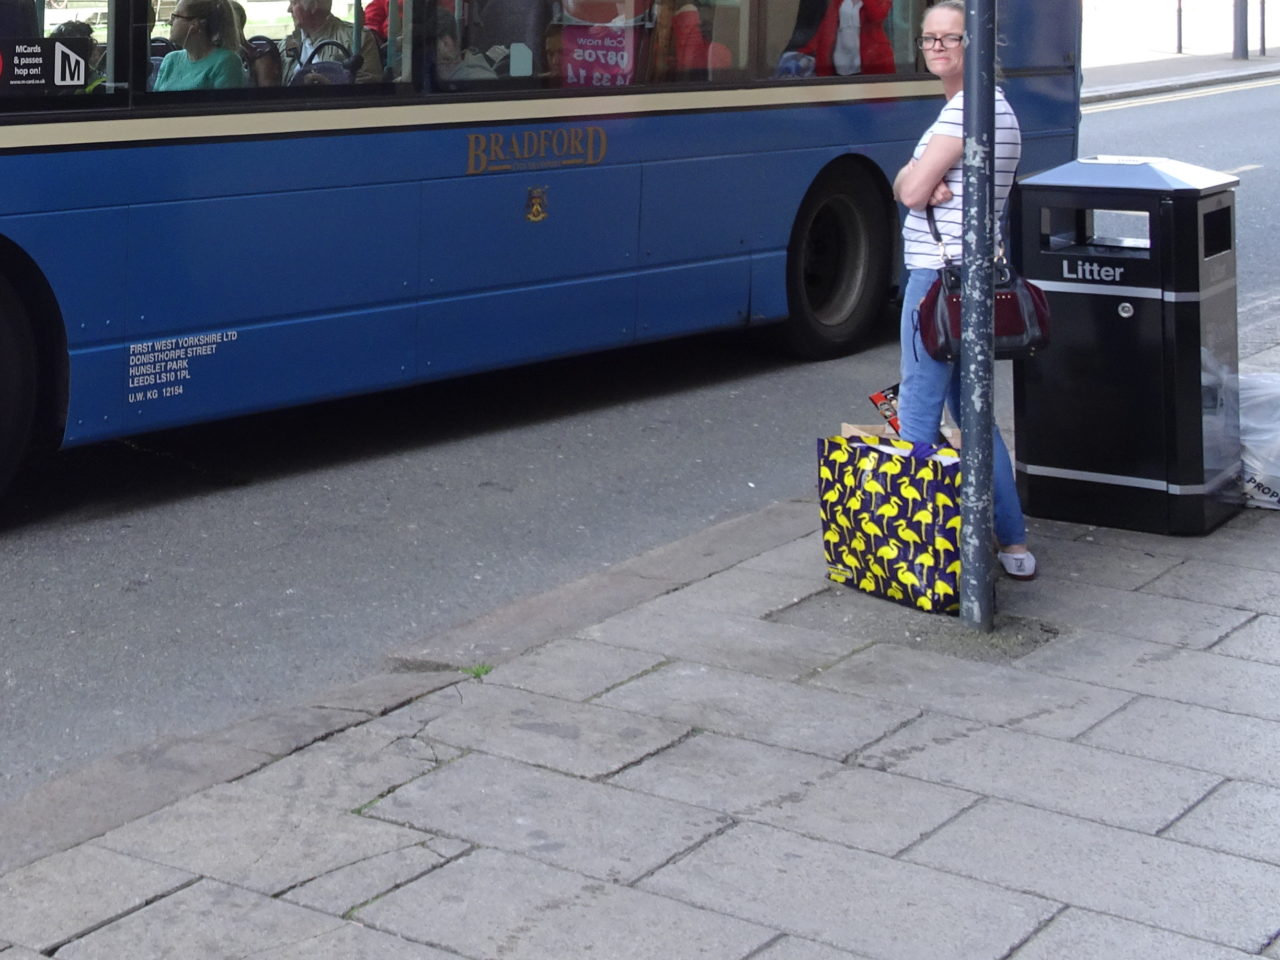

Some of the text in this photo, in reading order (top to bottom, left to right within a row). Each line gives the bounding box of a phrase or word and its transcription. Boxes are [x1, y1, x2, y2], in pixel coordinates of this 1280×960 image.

[15, 44, 41, 53] MCards
[13, 56, 43, 65] & passes
[14, 67, 41, 76] hop on!
[465, 126, 608, 175] BRADFORD
[1062, 259, 1124, 281] Litter
[130, 331, 237, 354] FIRST WEST YORKSHIRE LTD
[130, 344, 217, 365] DONISTHORPE STREET
[129, 359, 189, 376] HUNSLET PARK
[129, 370, 191, 387] LEEDS LS10 1PL
[128, 385, 183, 403] U.W. KG 12154
[1246, 476, 1280, 504] PROP
